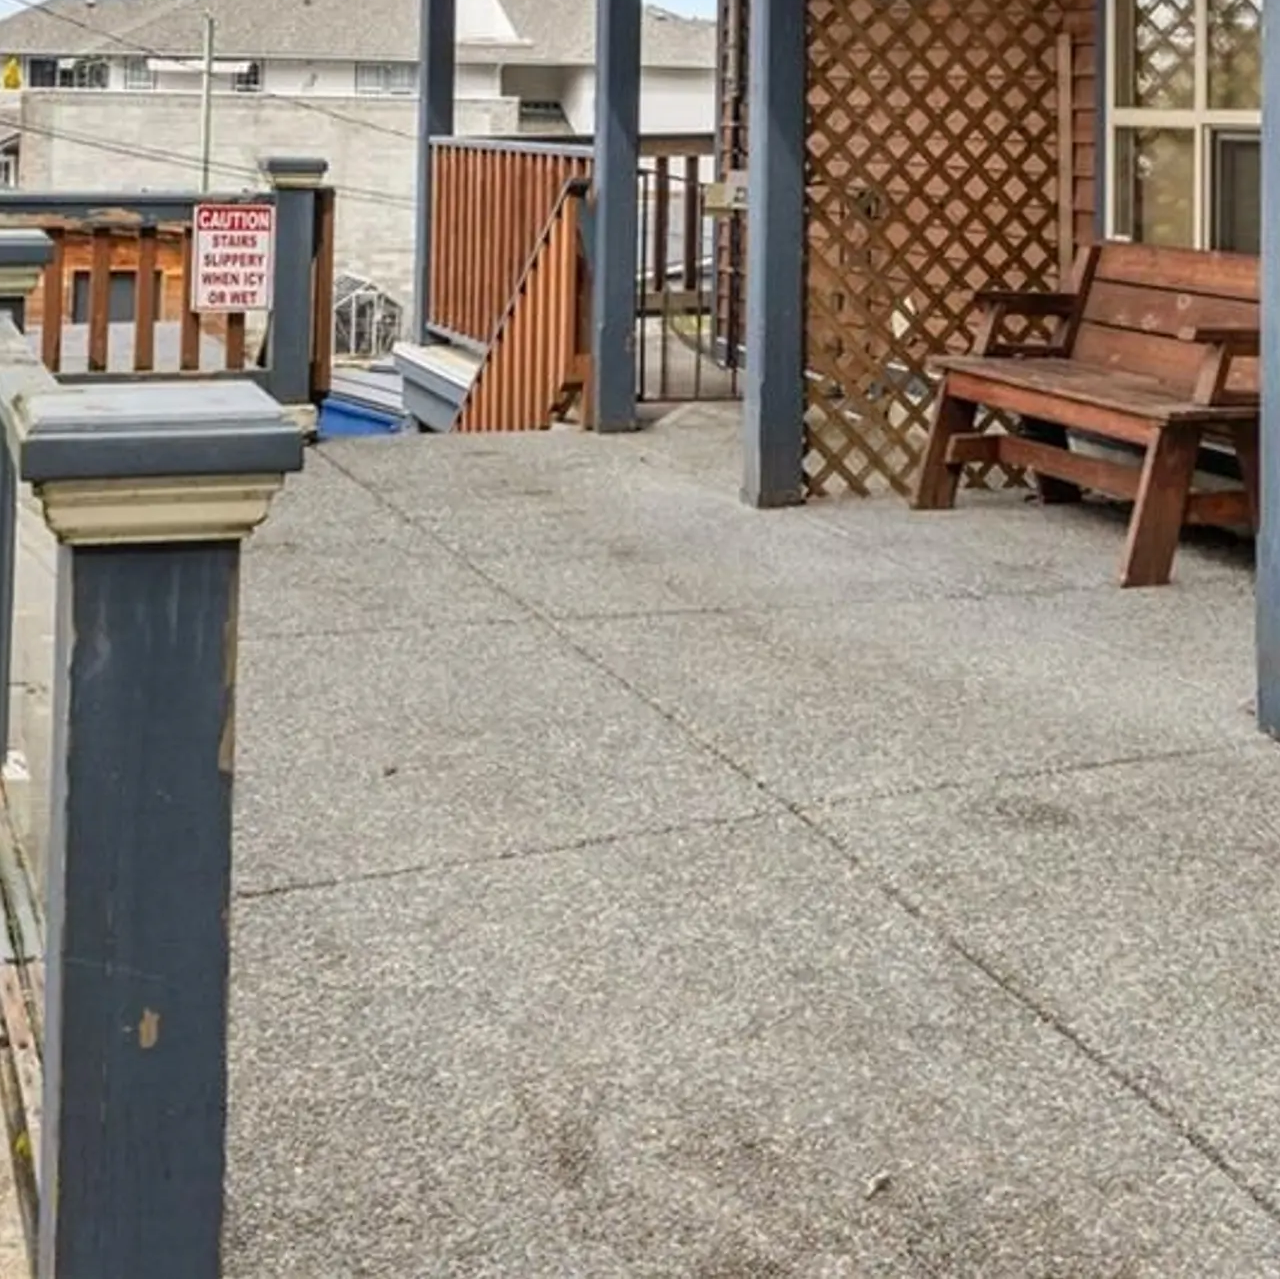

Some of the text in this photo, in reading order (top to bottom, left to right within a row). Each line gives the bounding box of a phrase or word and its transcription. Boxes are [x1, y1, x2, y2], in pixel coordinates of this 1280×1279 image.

[200, 210, 270, 228] CAUTION
[212, 234, 257, 248] STAIRS
[203, 253, 265, 267] SLIPPERY
[201, 272, 265, 286] WHEN ICY
[207, 290, 257, 304] OR WET
